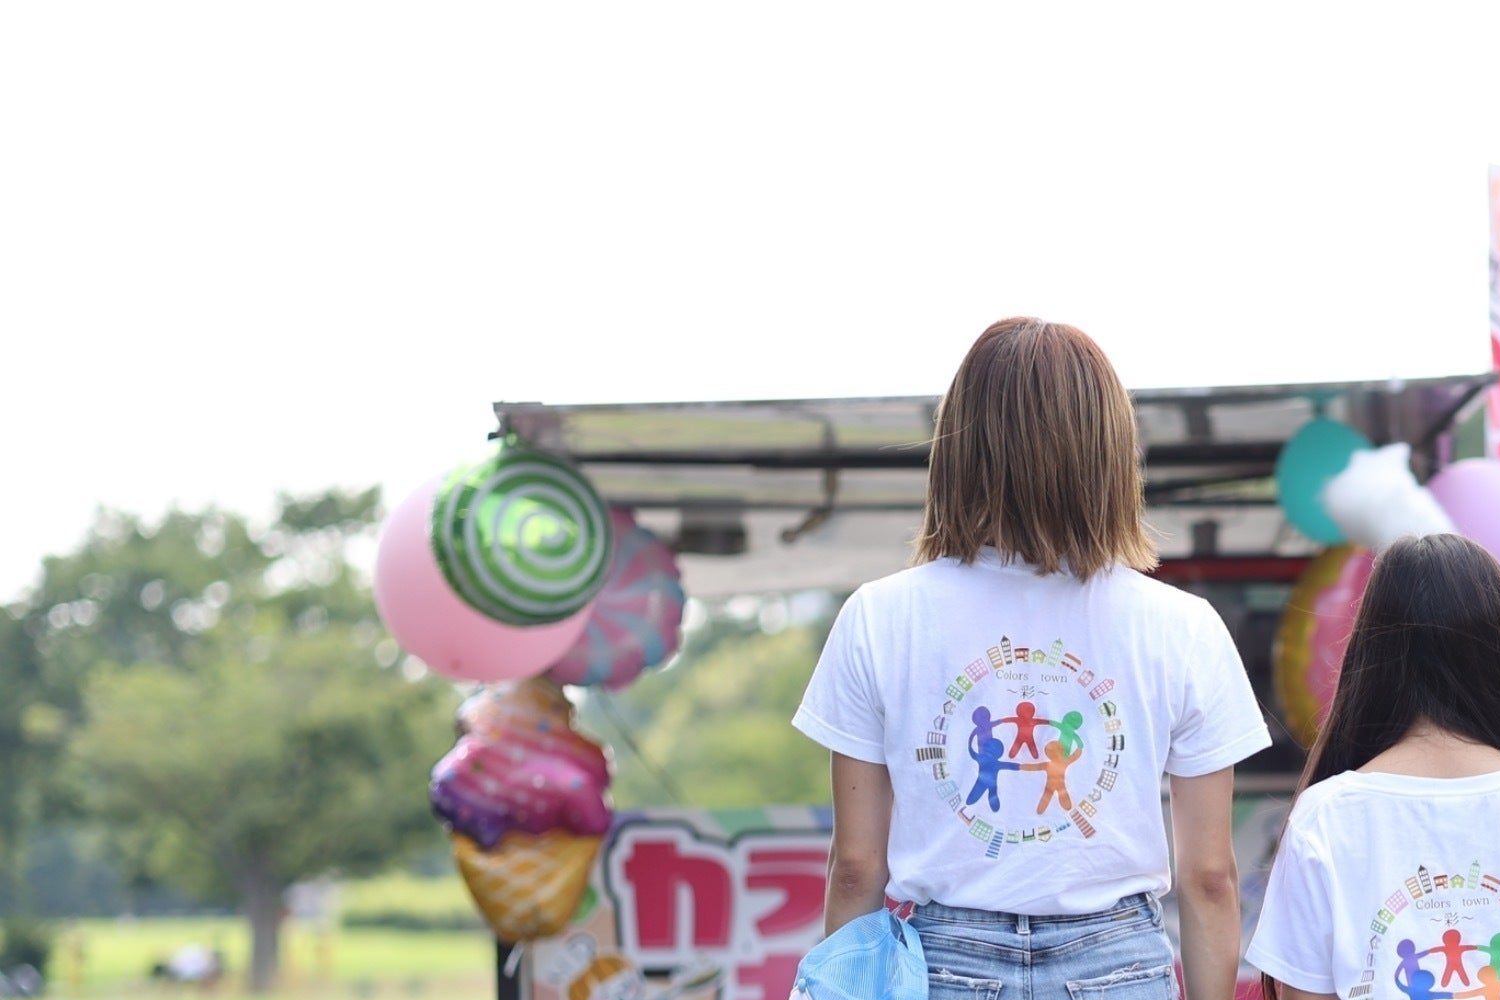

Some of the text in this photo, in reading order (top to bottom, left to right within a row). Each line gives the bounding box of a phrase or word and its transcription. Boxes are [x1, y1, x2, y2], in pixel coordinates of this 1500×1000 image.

[996, 669, 1067, 683] Colors town
[1415, 898, 1490, 910] Colors town
